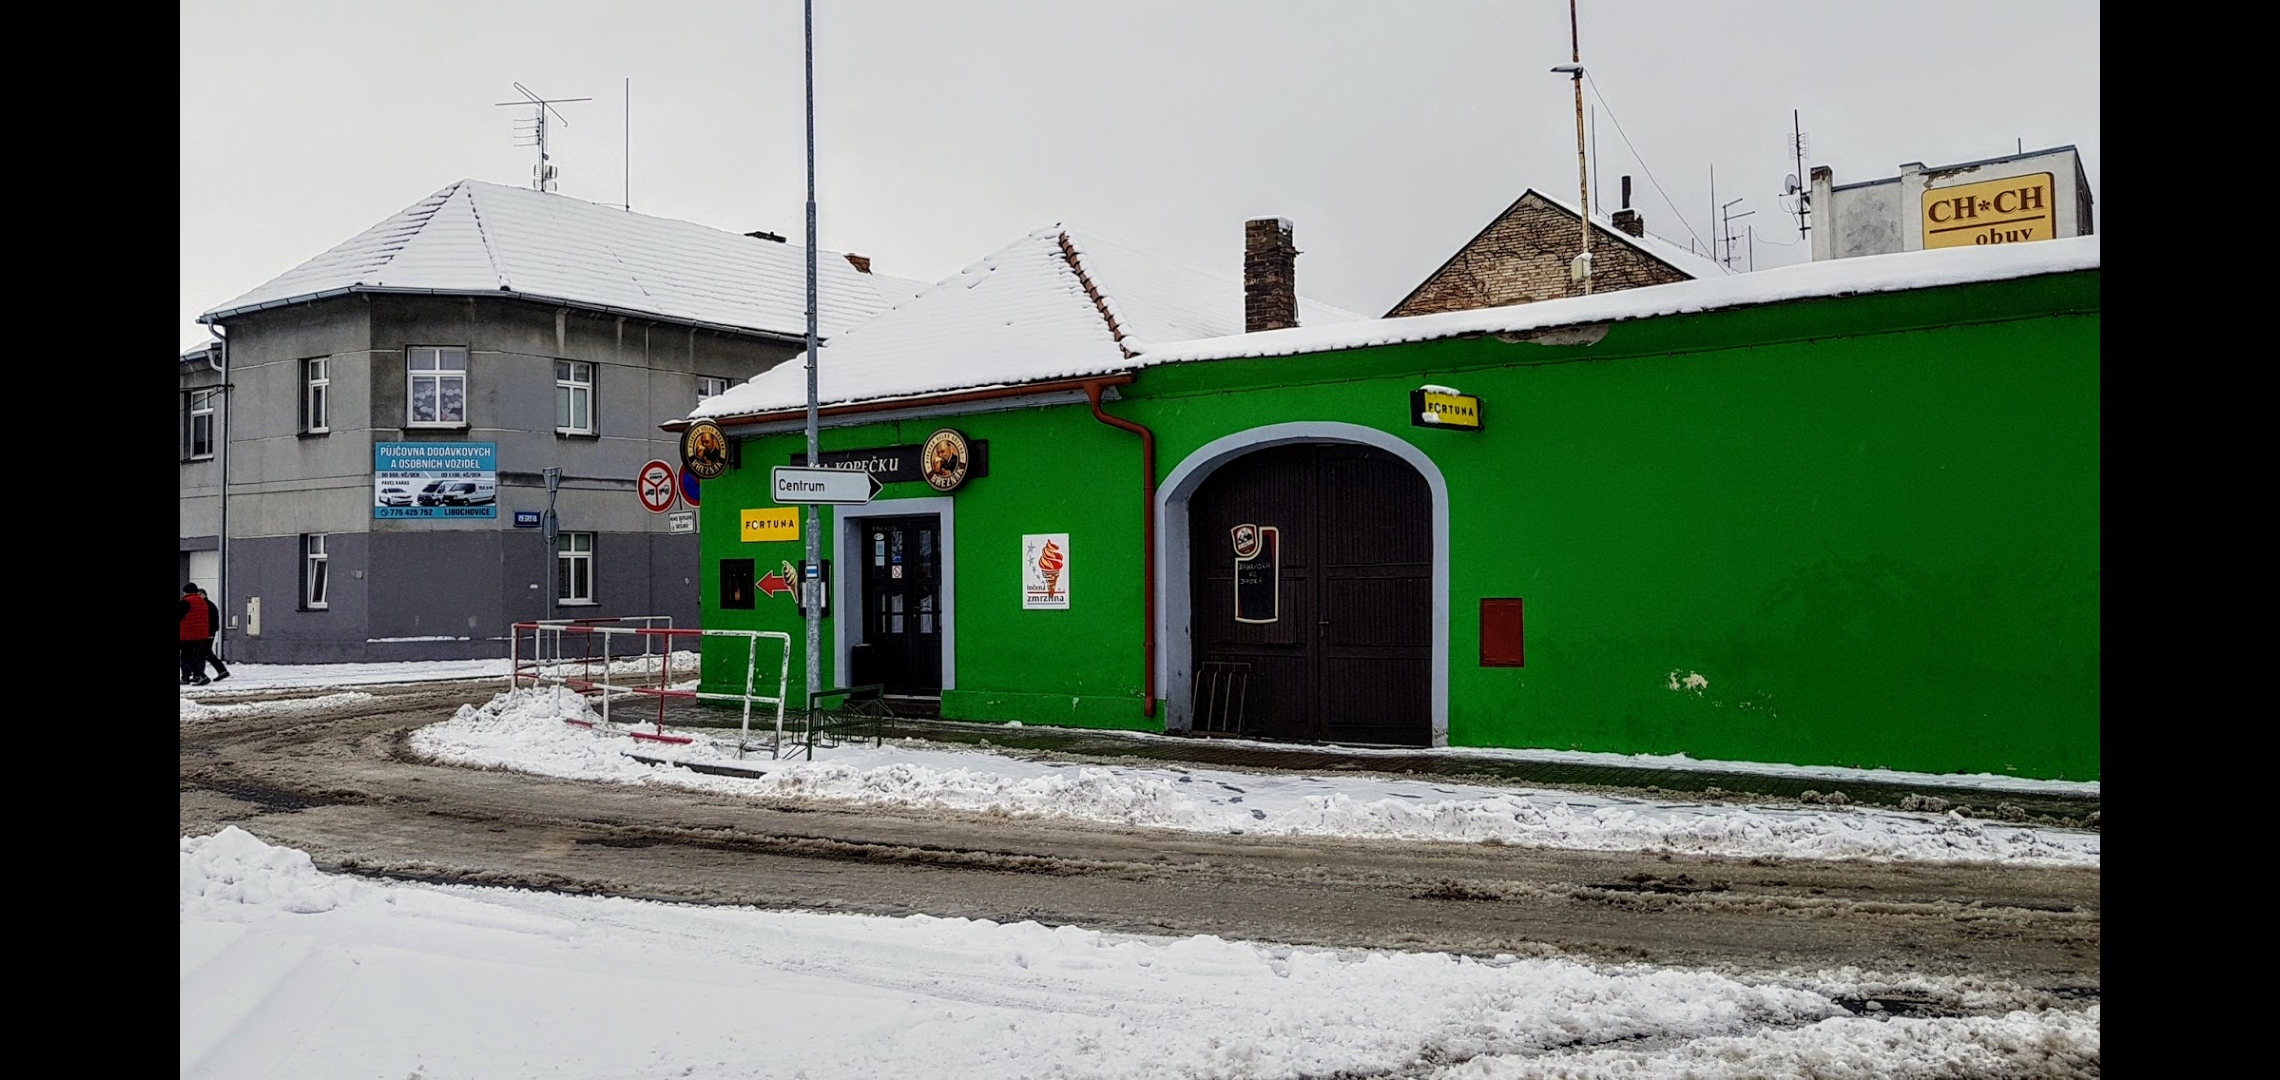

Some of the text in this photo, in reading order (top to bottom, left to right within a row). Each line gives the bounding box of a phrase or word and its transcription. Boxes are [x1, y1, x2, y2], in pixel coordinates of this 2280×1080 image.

[1975, 228, 2034, 246] obuv
[1428, 402, 1474, 417] FORTUNA
[380, 445, 491, 457] PŮJČOVNA DODÁVKOVÝCH
[390, 457, 480, 469] A OSOBNÍCH VOZIDEL
[779, 479, 825, 492] Centrum
[444, 508, 491, 516] LIBOCHOVICE
[745, 519, 795, 530] FORTUNA
